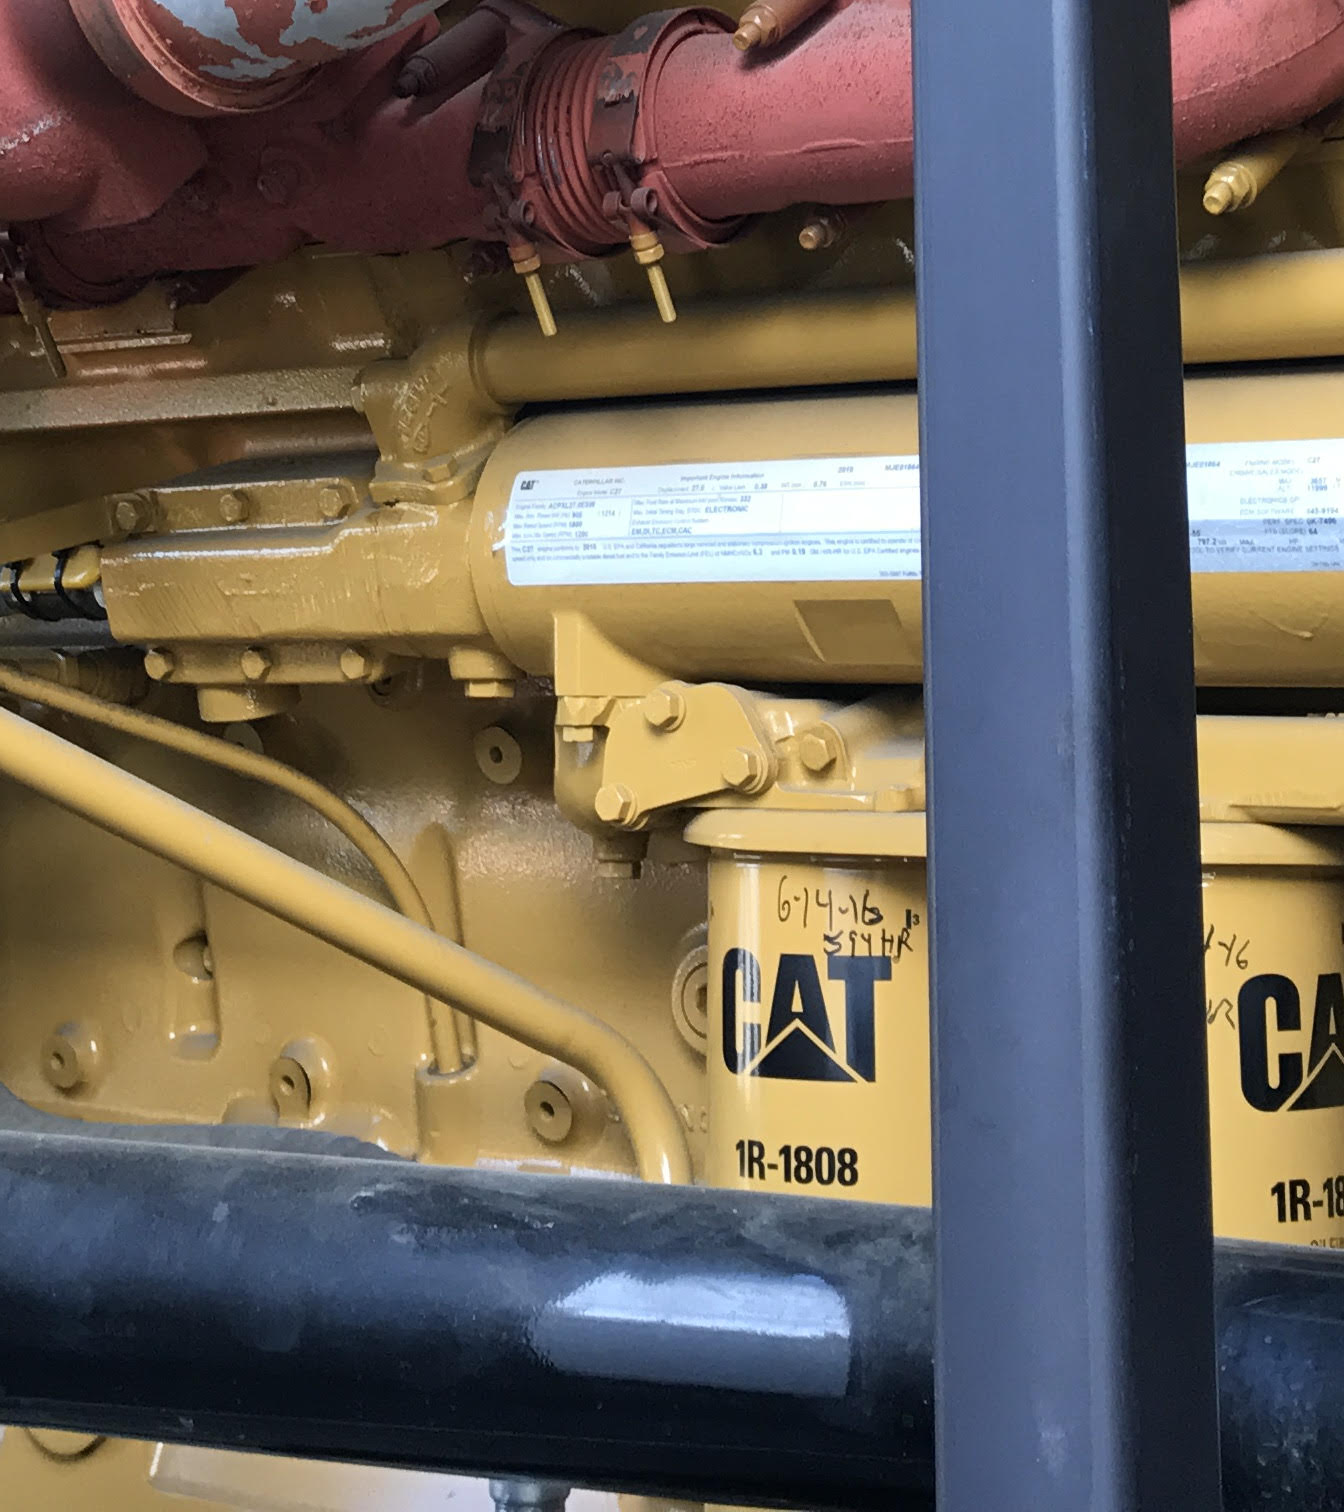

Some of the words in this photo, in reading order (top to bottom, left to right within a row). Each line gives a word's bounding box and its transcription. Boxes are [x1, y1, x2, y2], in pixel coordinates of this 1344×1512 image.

[520, 479, 537, 491] CAT
[705, 505, 749, 513] ELECTRONIC
[721, 947, 892, 1083] CAT
[735, 1139, 859, 1187] 1R-1808
